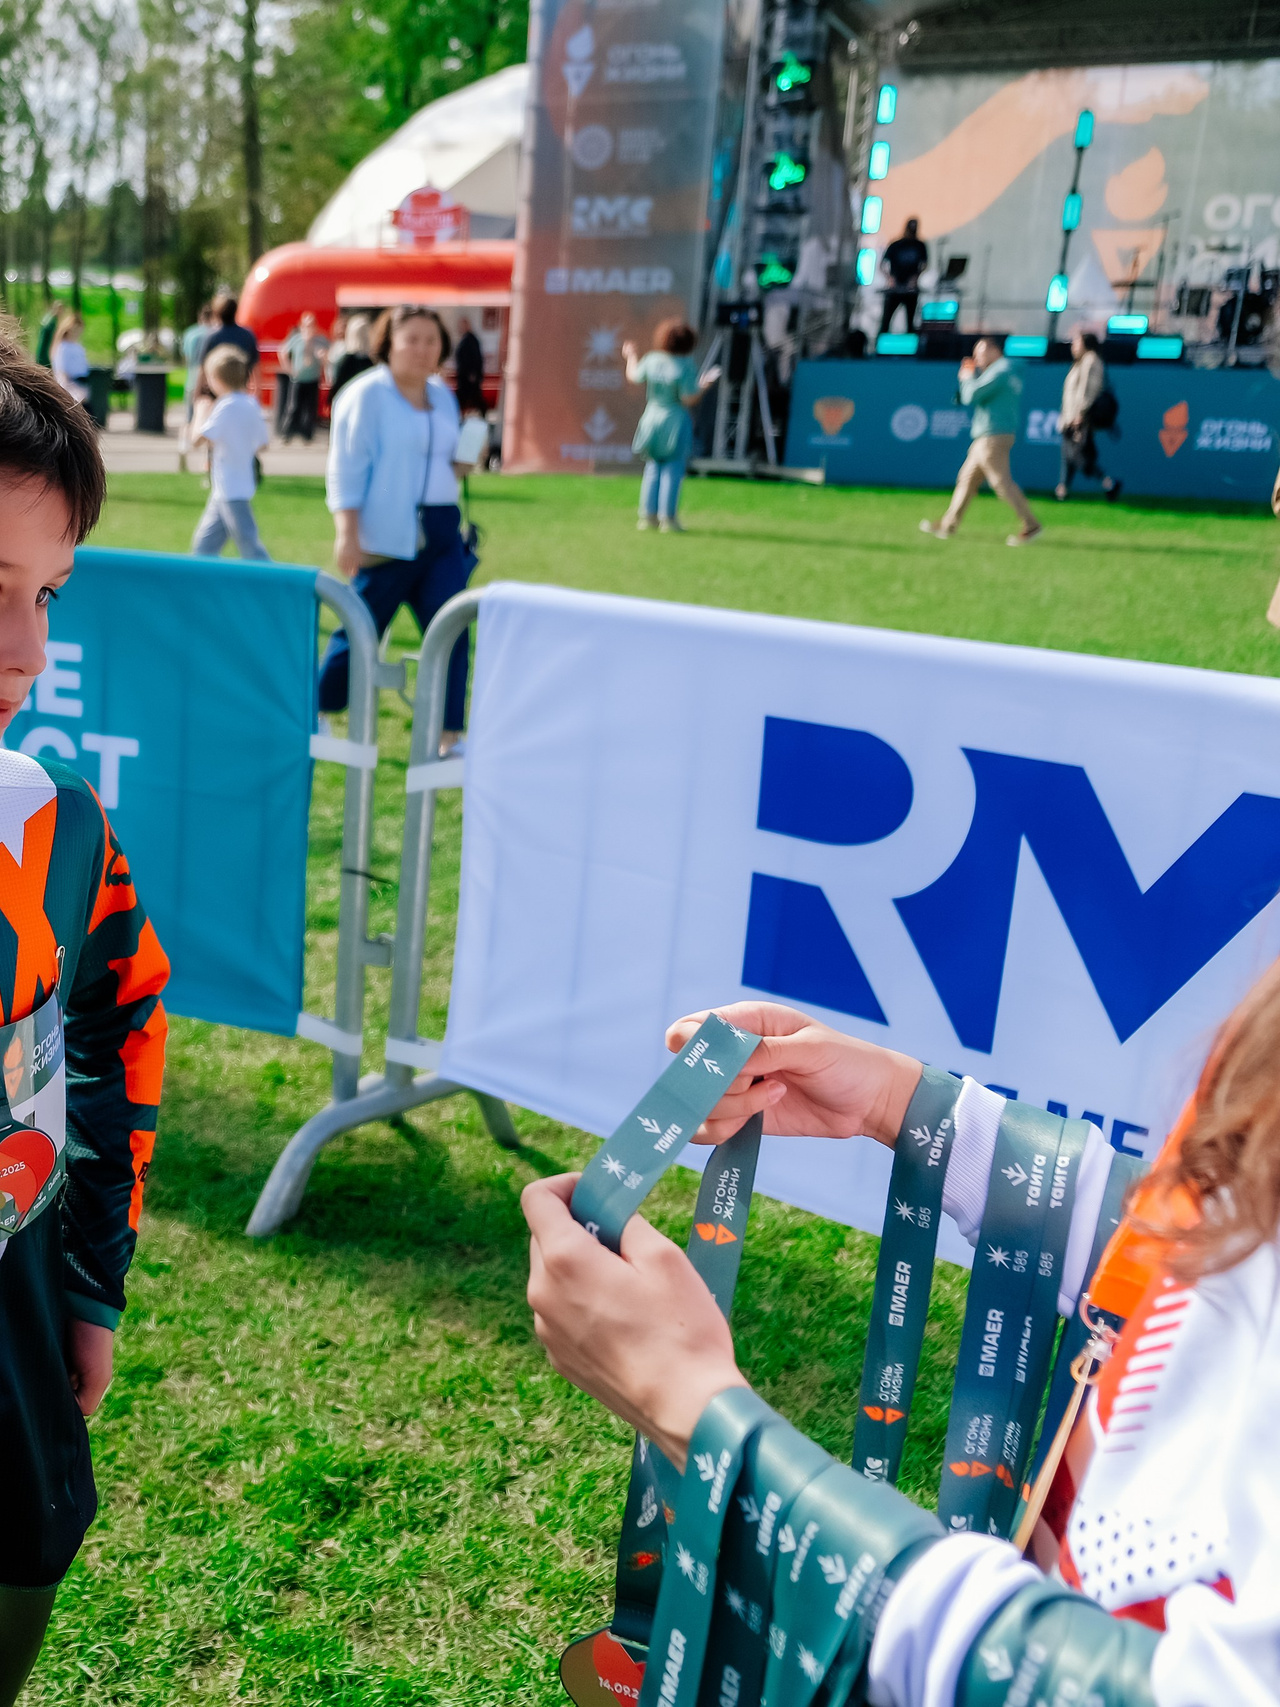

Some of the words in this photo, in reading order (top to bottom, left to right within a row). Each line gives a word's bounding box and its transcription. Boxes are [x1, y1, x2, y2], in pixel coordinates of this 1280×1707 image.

[1203, 193, 1280, 232] ОГ
[32, 1023, 60, 1059] ОГОНЬ
[712, 1169, 730, 1215] ОГОНЬ
[722, 1167, 741, 1221] ЖИЗНИ
[917, 1206, 932, 1229] 585
[1012, 1249, 1029, 1273] 585
[1037, 1251, 1055, 1277] 585
[889, 1260, 912, 1314] MAER
[980, 1308, 1005, 1364] MAER
[878, 1364, 893, 1402] ОГОНЬ
[889, 1363, 905, 1404] ЖИЗНИ
[964, 1416, 981, 1456] ОГОНЬ
[976, 1413, 994, 1458] ЖИЗНИ
